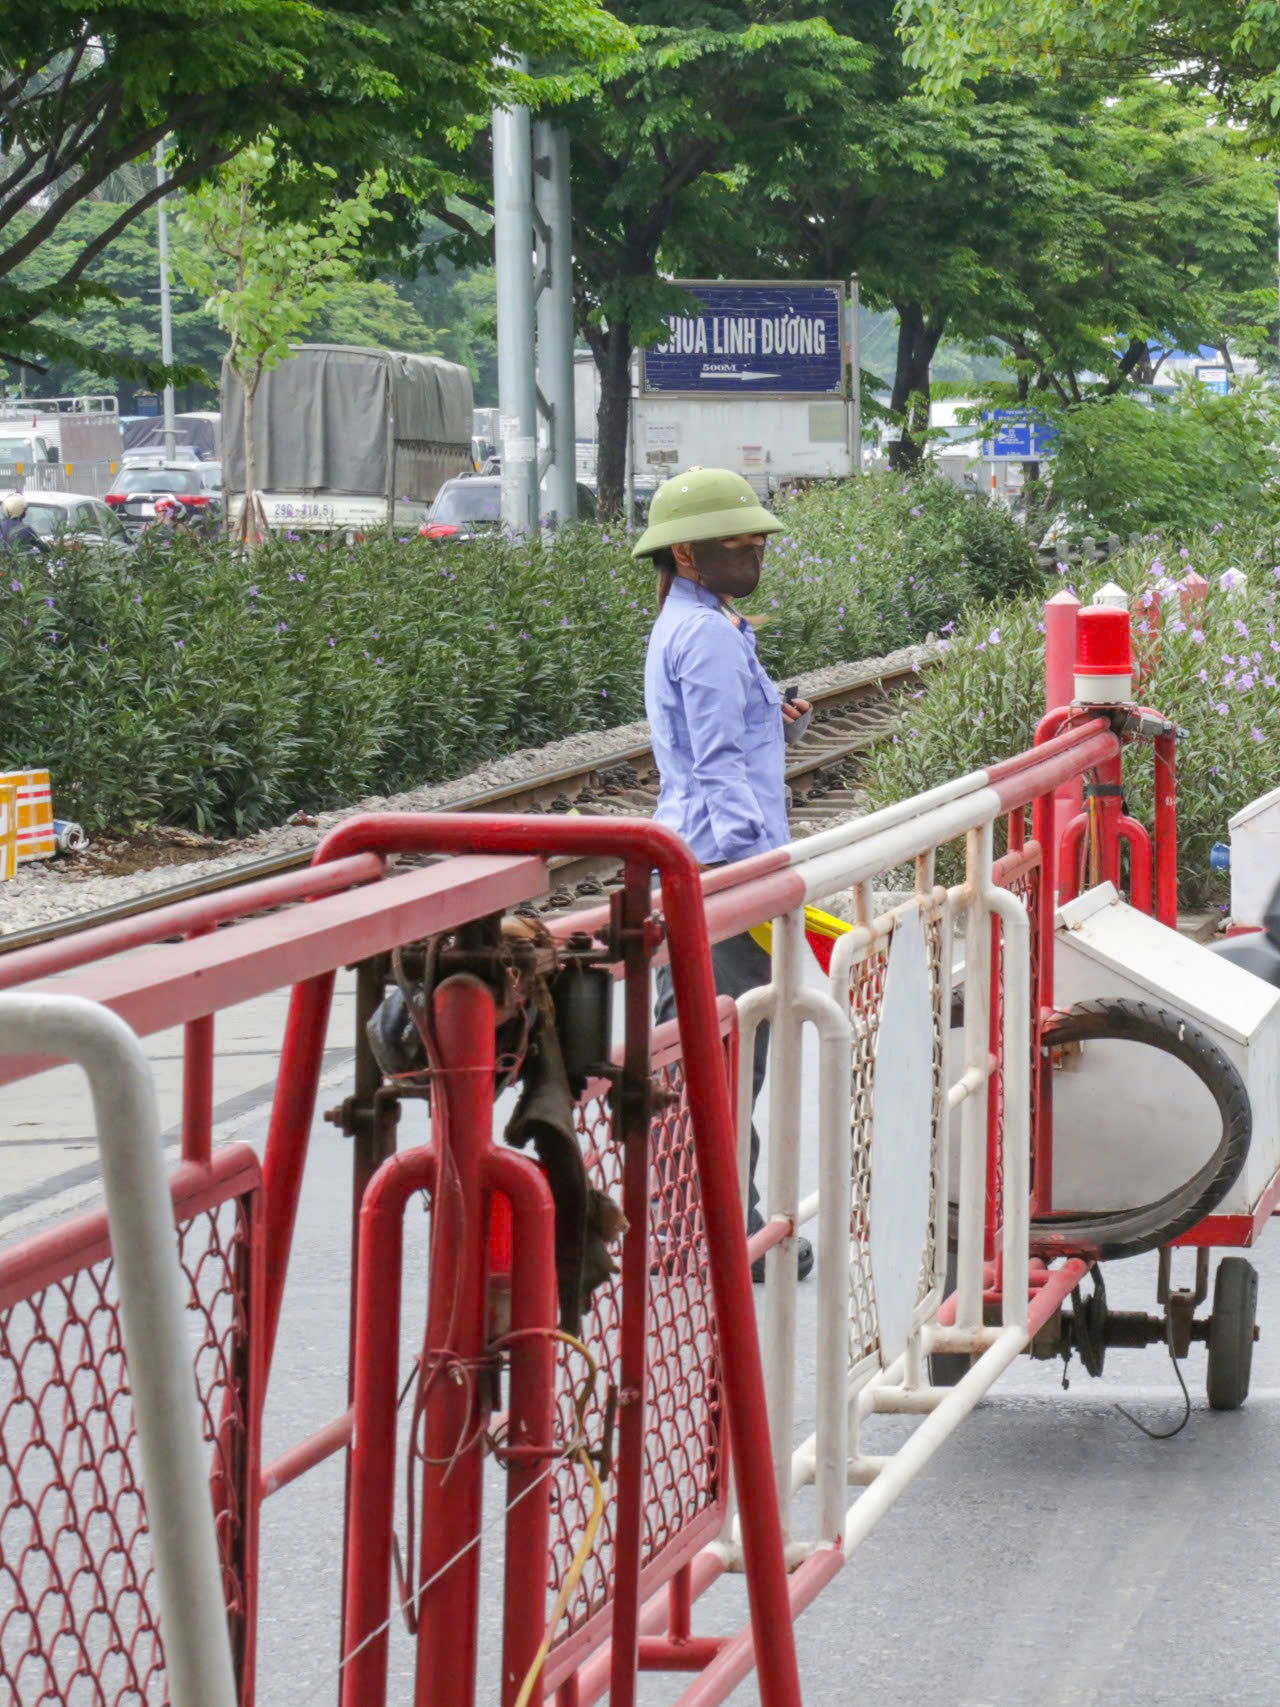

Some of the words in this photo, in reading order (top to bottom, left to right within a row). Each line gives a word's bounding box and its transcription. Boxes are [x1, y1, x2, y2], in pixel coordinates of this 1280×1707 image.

[713, 317, 756, 354] LINH
[761, 306, 826, 355] ĐƯỜNG
[702, 363, 737, 372] 500M
